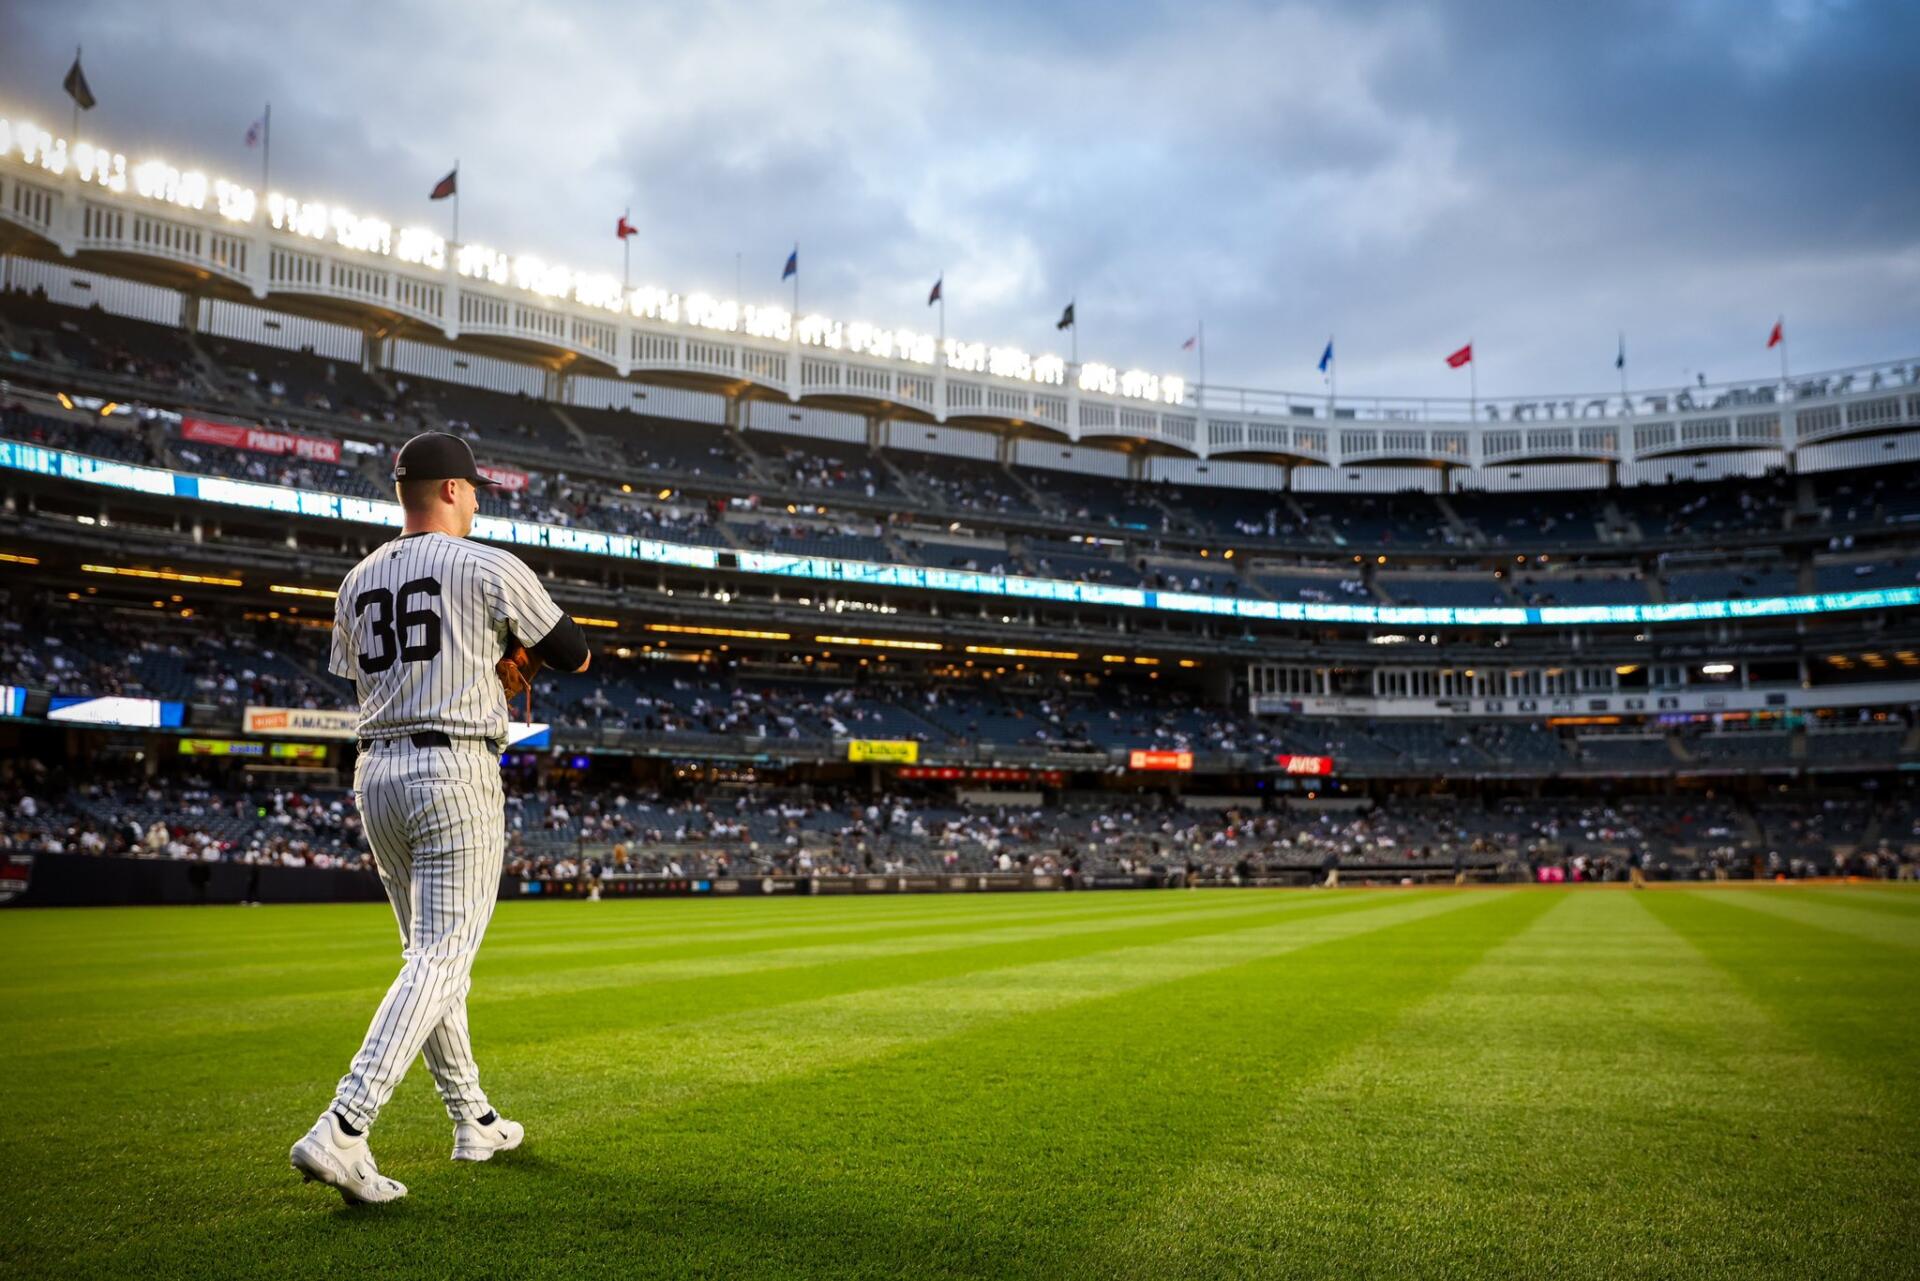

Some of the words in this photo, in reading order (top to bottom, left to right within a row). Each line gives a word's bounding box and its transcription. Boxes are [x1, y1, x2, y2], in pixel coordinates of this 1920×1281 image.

[247, 431, 295, 453] PARTY
[297, 439, 336, 461] DECK
[355, 577, 442, 674] 36
[1287, 756, 1321, 774] AVIS
